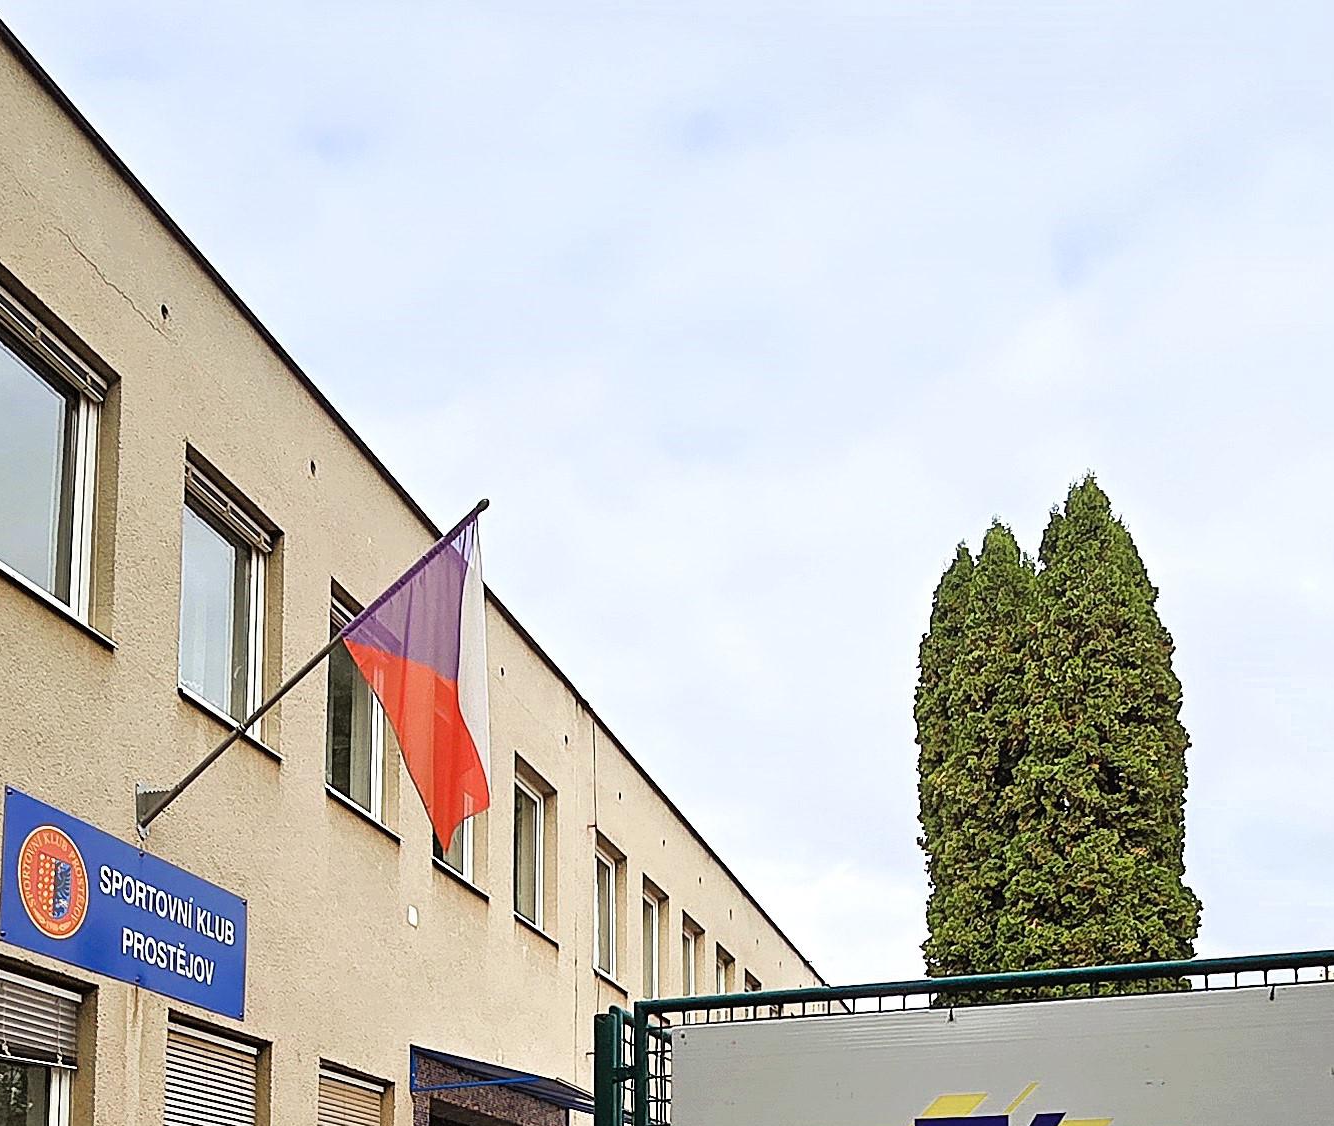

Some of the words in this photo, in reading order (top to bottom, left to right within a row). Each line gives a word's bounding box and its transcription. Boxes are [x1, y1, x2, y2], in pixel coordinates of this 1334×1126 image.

[43, 832, 68, 852] KLUB
[99, 865, 194, 929] SPORTOVNÍ
[196, 906, 235, 946] KLUB
[122, 927, 215, 986] PROSTĚJOV
